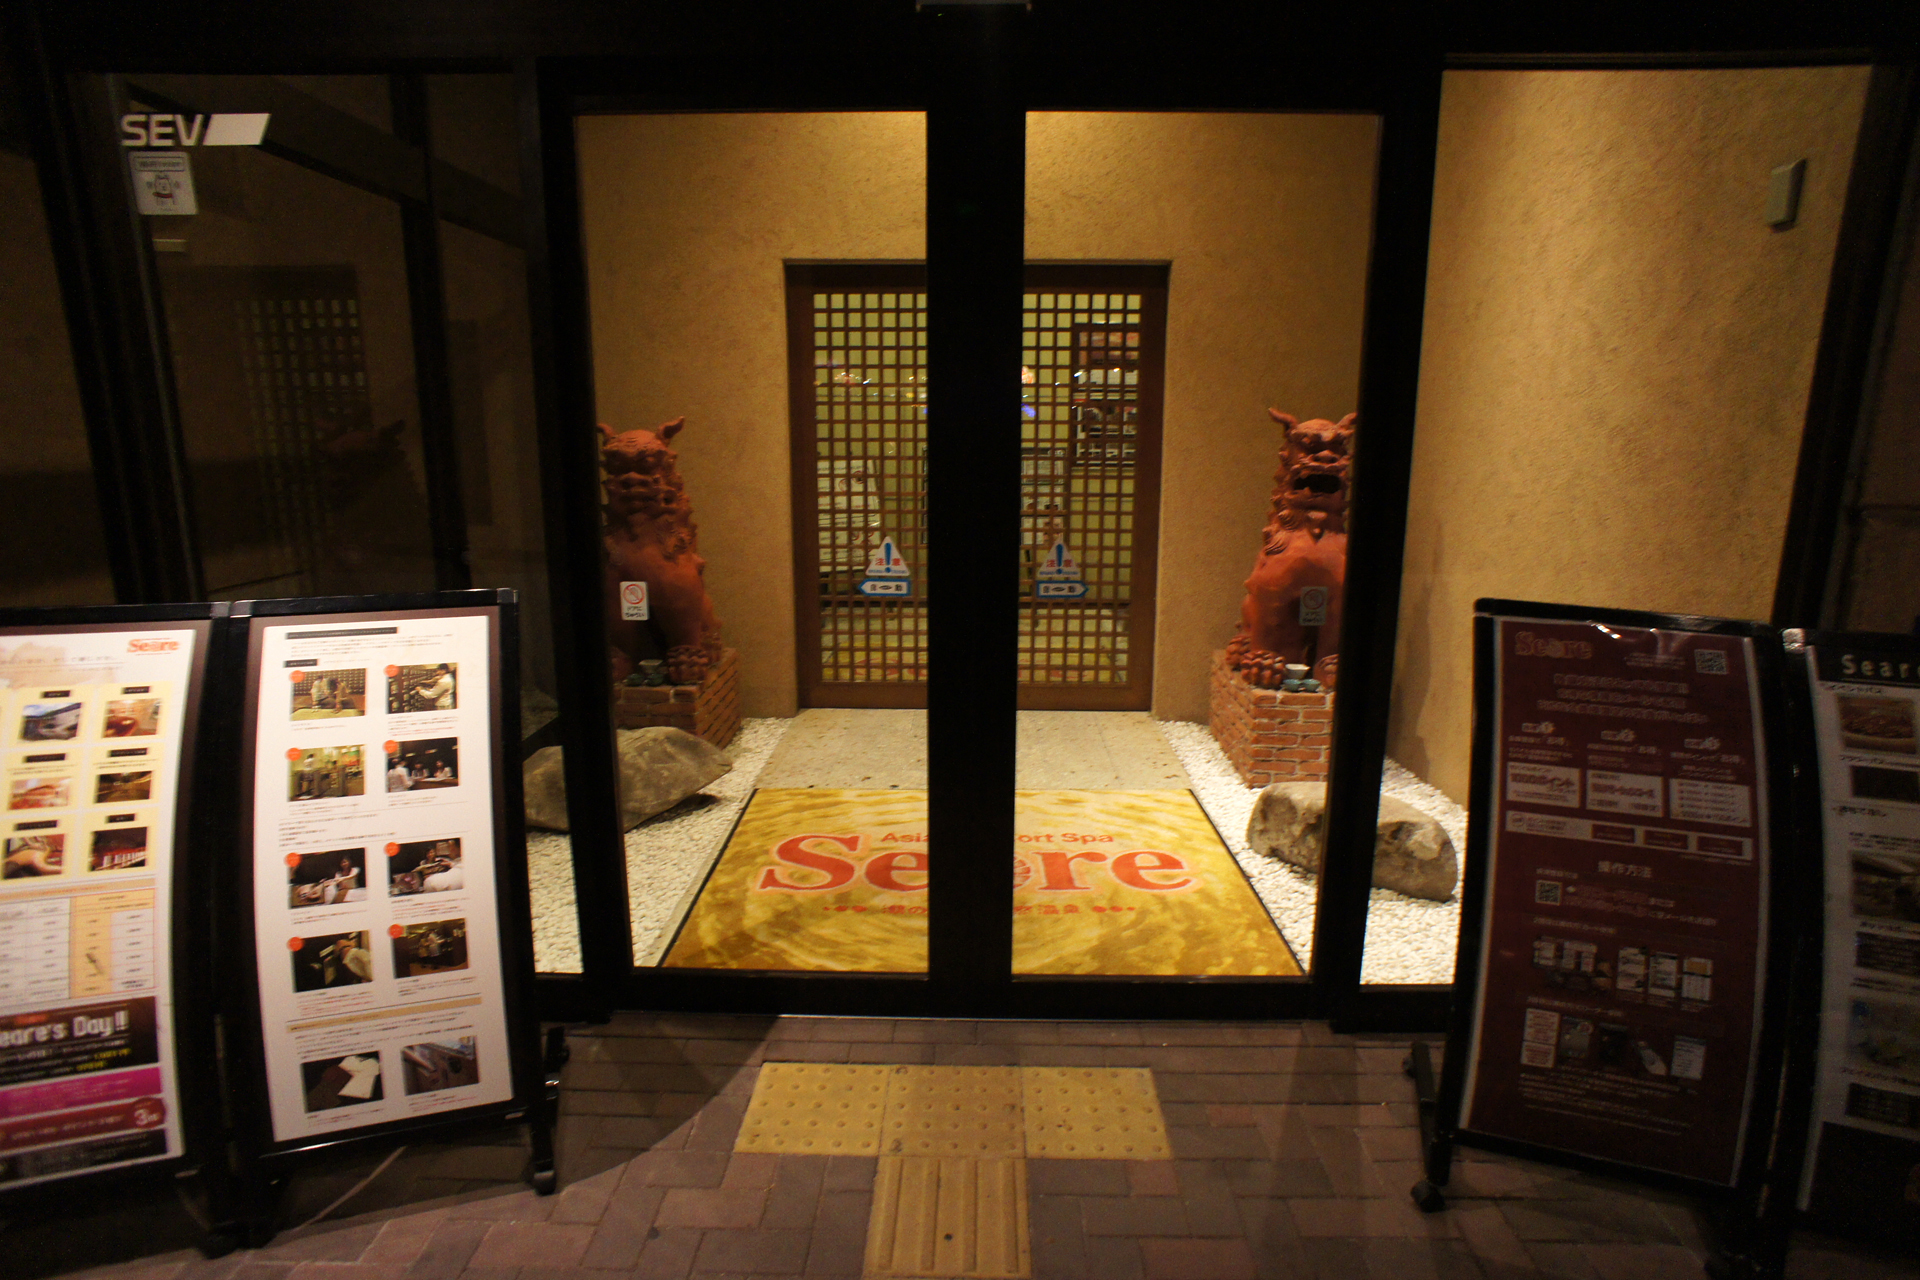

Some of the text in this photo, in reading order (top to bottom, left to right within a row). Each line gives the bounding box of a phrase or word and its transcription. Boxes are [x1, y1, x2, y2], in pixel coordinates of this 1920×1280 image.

[126, 638, 179, 653] Seare
[1514, 631, 1593, 660] Seare
[1841, 653, 1920, 679] Sear
[1061, 833, 1113, 845] Spa
